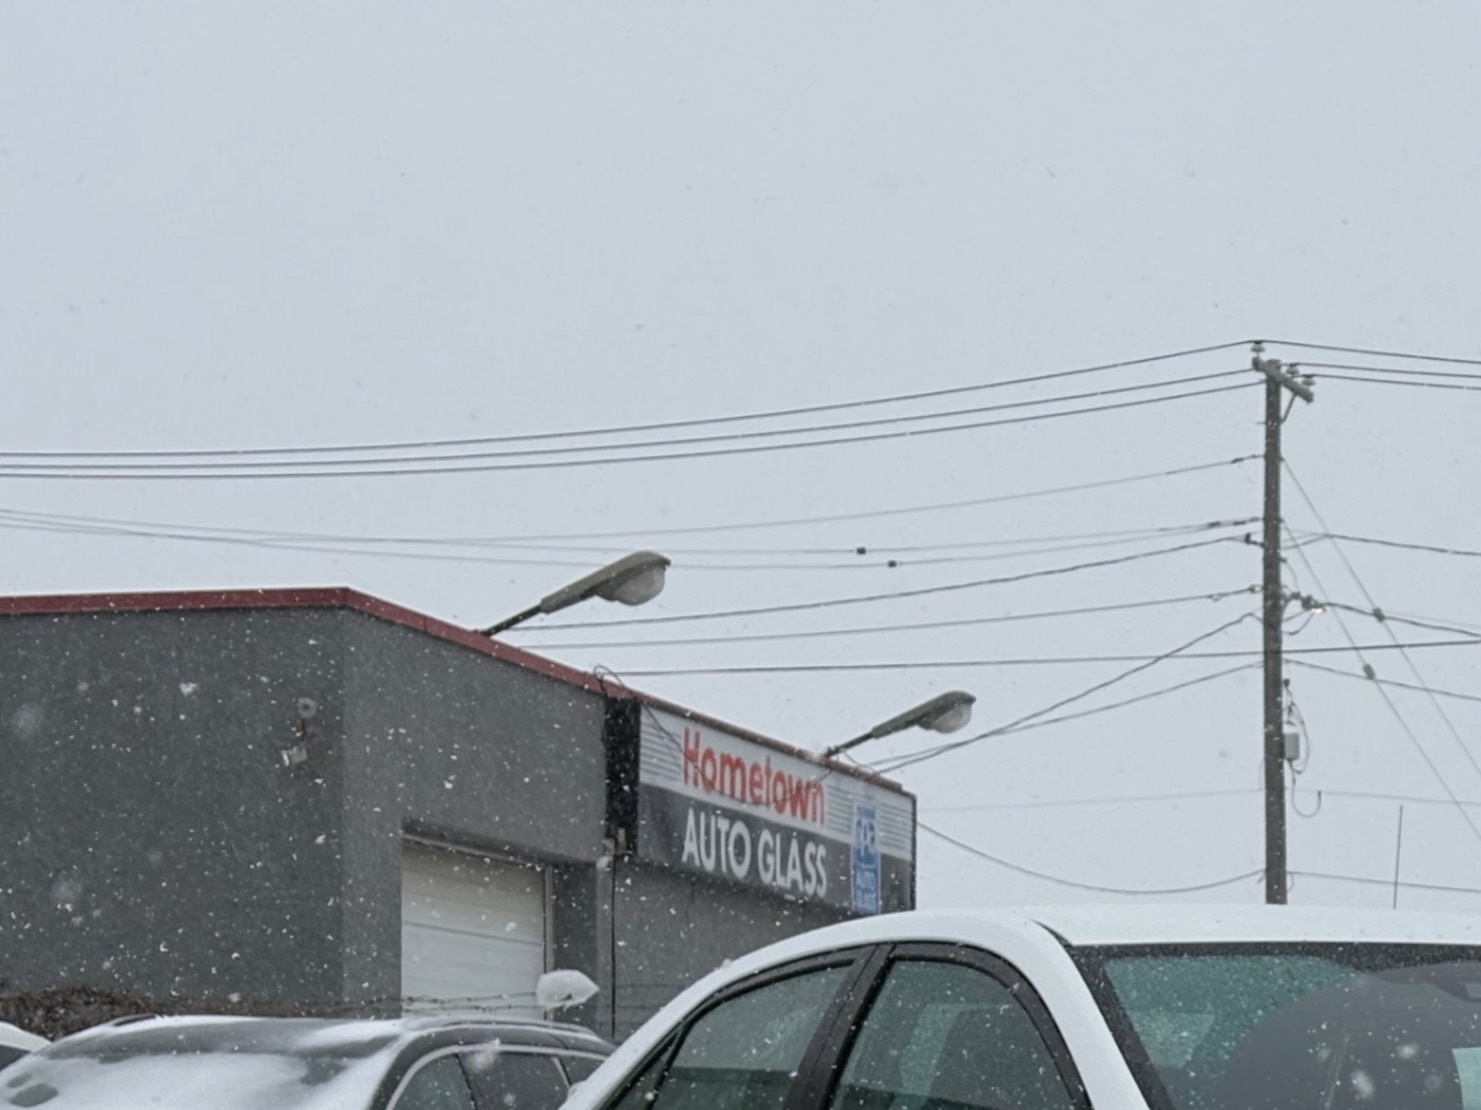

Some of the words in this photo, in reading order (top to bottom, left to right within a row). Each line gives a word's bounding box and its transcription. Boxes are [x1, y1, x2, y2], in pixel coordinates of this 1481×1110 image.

[683, 727, 825, 825] Hometown
[681, 808, 751, 879] AUTO
[758, 829, 827, 898] GLASS
